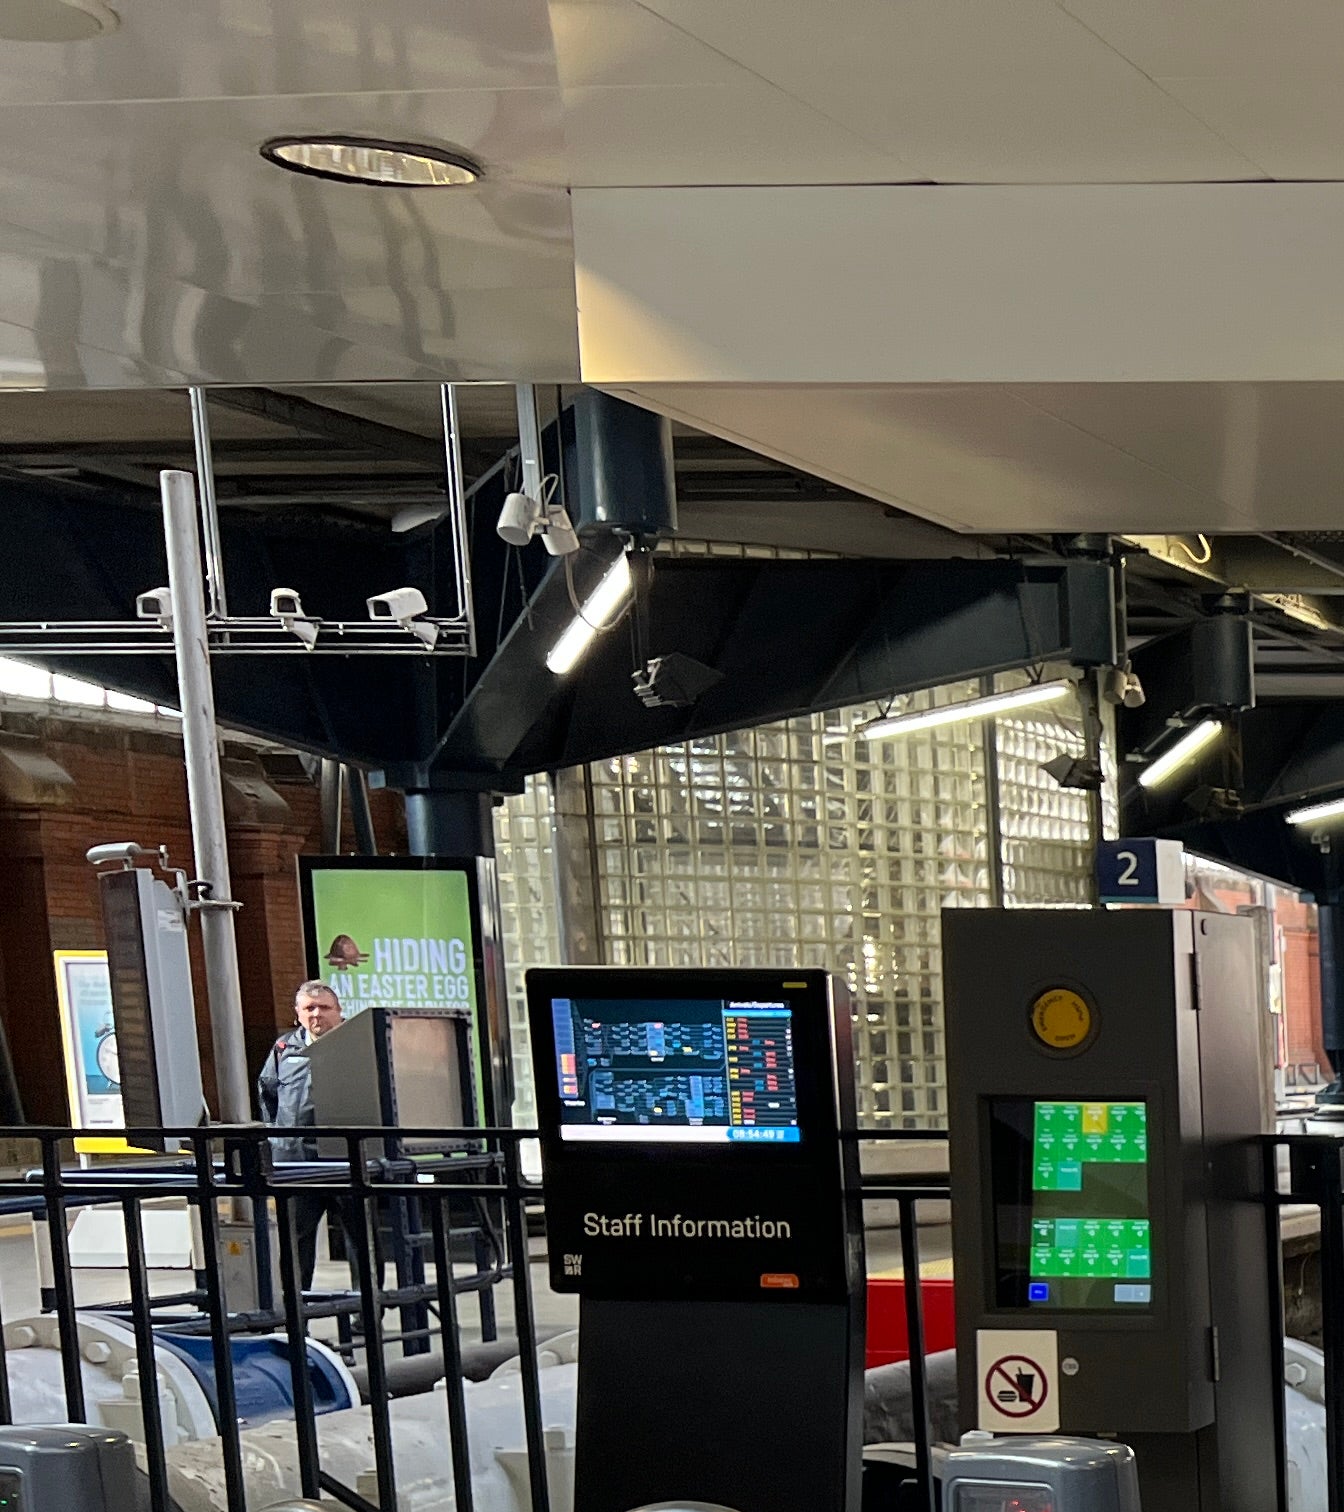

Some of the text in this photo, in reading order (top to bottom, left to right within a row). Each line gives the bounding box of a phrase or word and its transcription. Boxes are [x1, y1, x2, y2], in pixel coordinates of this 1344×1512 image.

[1116, 852, 1139, 885] 2
[373, 938, 466, 974] HIDING
[357, 974, 429, 999] EASTER
[434, 975, 469, 1000] EGG
[583, 1212, 792, 1239] Staff Information
